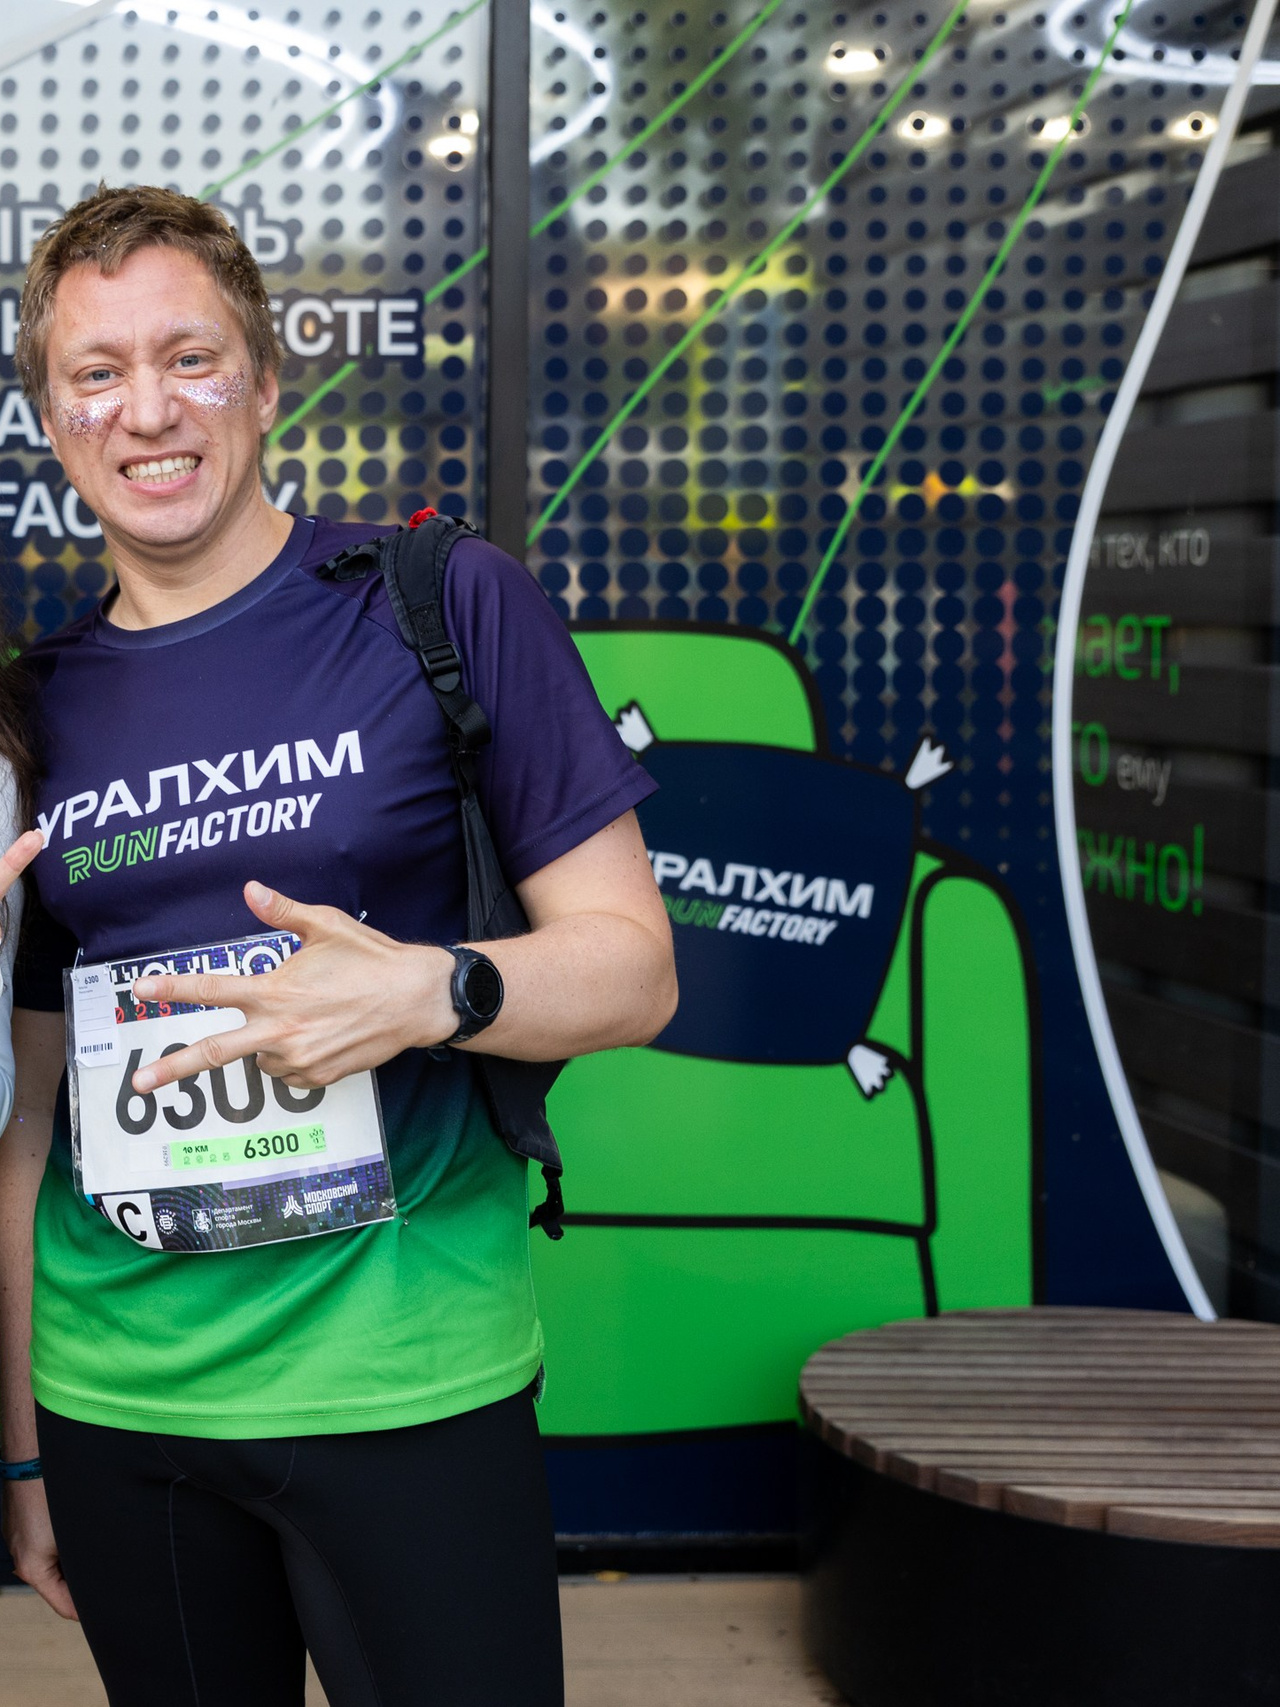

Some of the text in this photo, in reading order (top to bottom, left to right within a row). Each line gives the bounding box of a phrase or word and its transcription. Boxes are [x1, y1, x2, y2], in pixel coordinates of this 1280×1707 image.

[1159, 527, 1210, 567] кто
[37, 730, 364, 850] УРАЛХИМ
[183, 1146, 193, 1154] 10
[244, 1133, 300, 1159] 6300
[304, 1180, 358, 1204] МОСКОВСКИЙ
[213, 1204, 253, 1215] Департамент
[305, 1200, 332, 1215] СПОРТ
[116, 1201, 148, 1242] C
[215, 1214, 236, 1222] спорта
[216, 1217, 262, 1230] города Москвы
